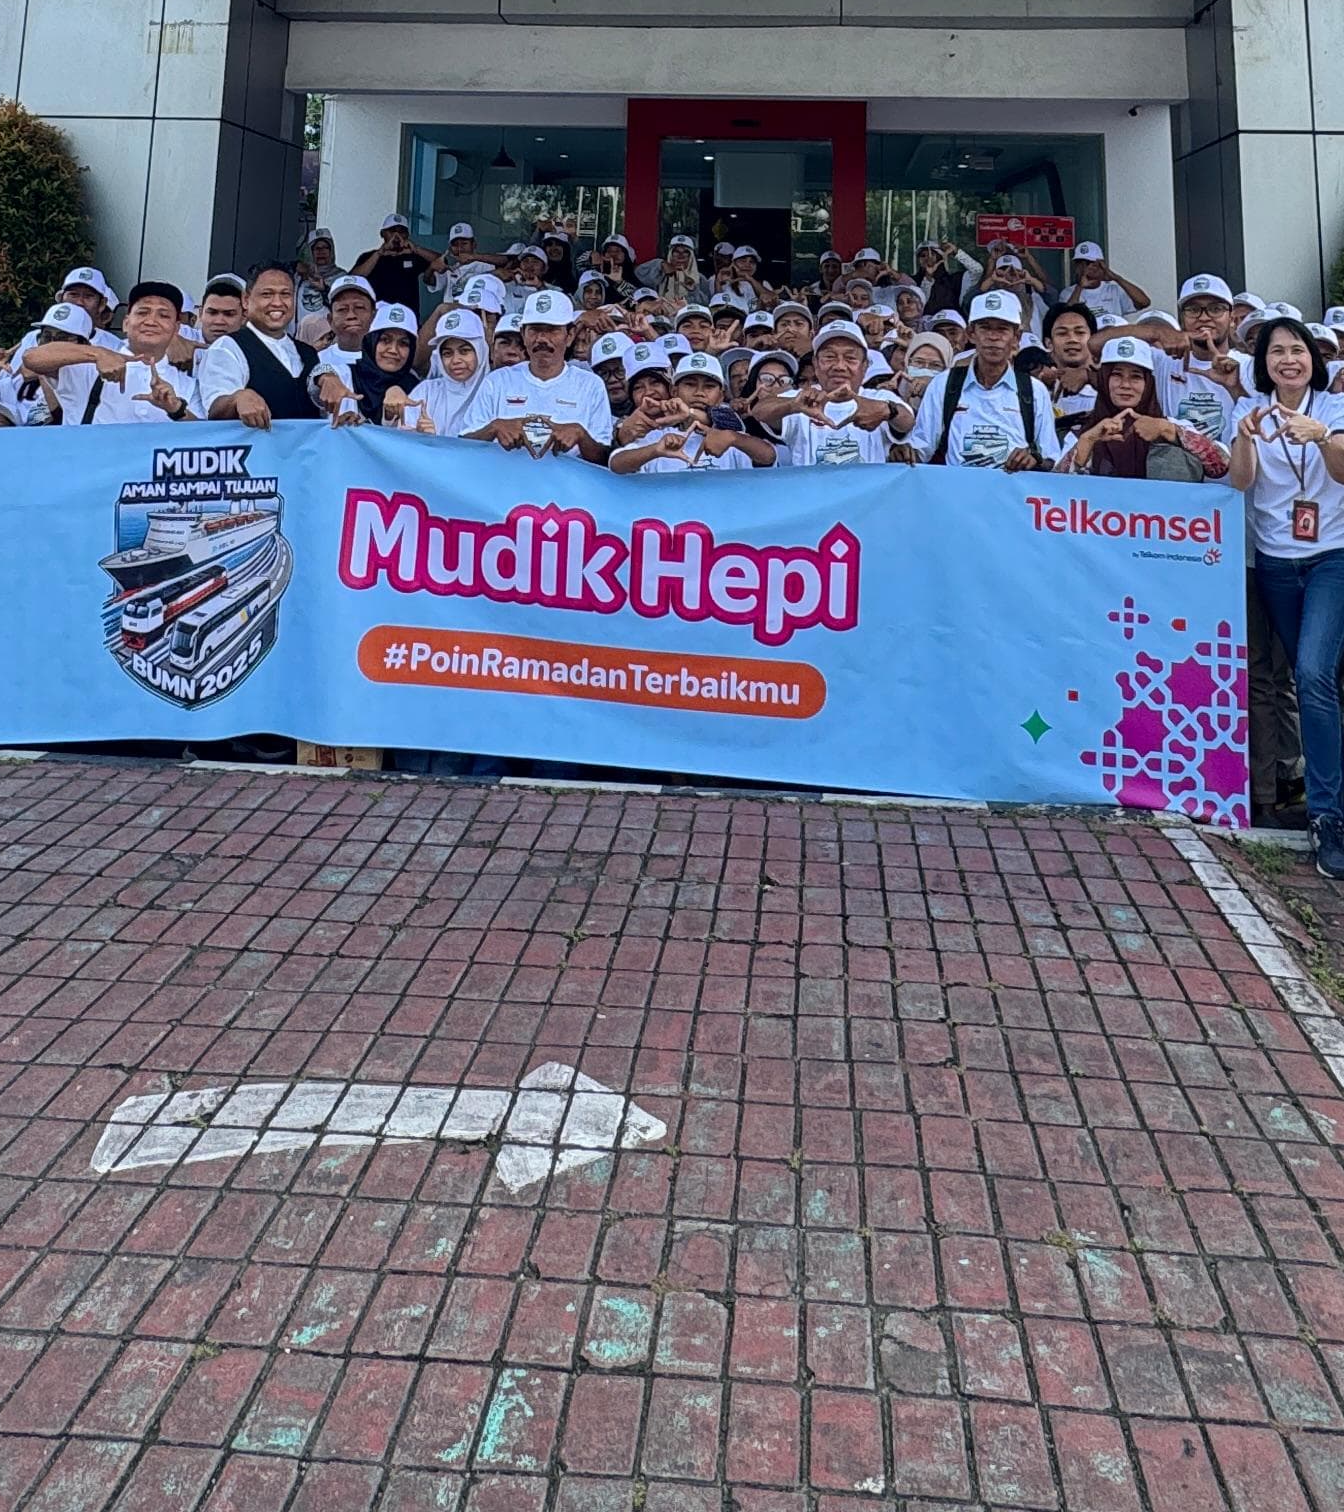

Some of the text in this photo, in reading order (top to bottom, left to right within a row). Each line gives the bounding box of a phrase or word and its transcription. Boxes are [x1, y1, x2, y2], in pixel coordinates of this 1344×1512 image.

[156, 449, 245, 476] MUDIK
[122, 479, 276, 498] AMAN SAMPAI TUJUAN
[1025, 497, 1222, 544] Telkomsel
[133, 631, 263, 700] BUMN 2025
[383, 641, 800, 706] #PoinRamadanTerbaikmu
